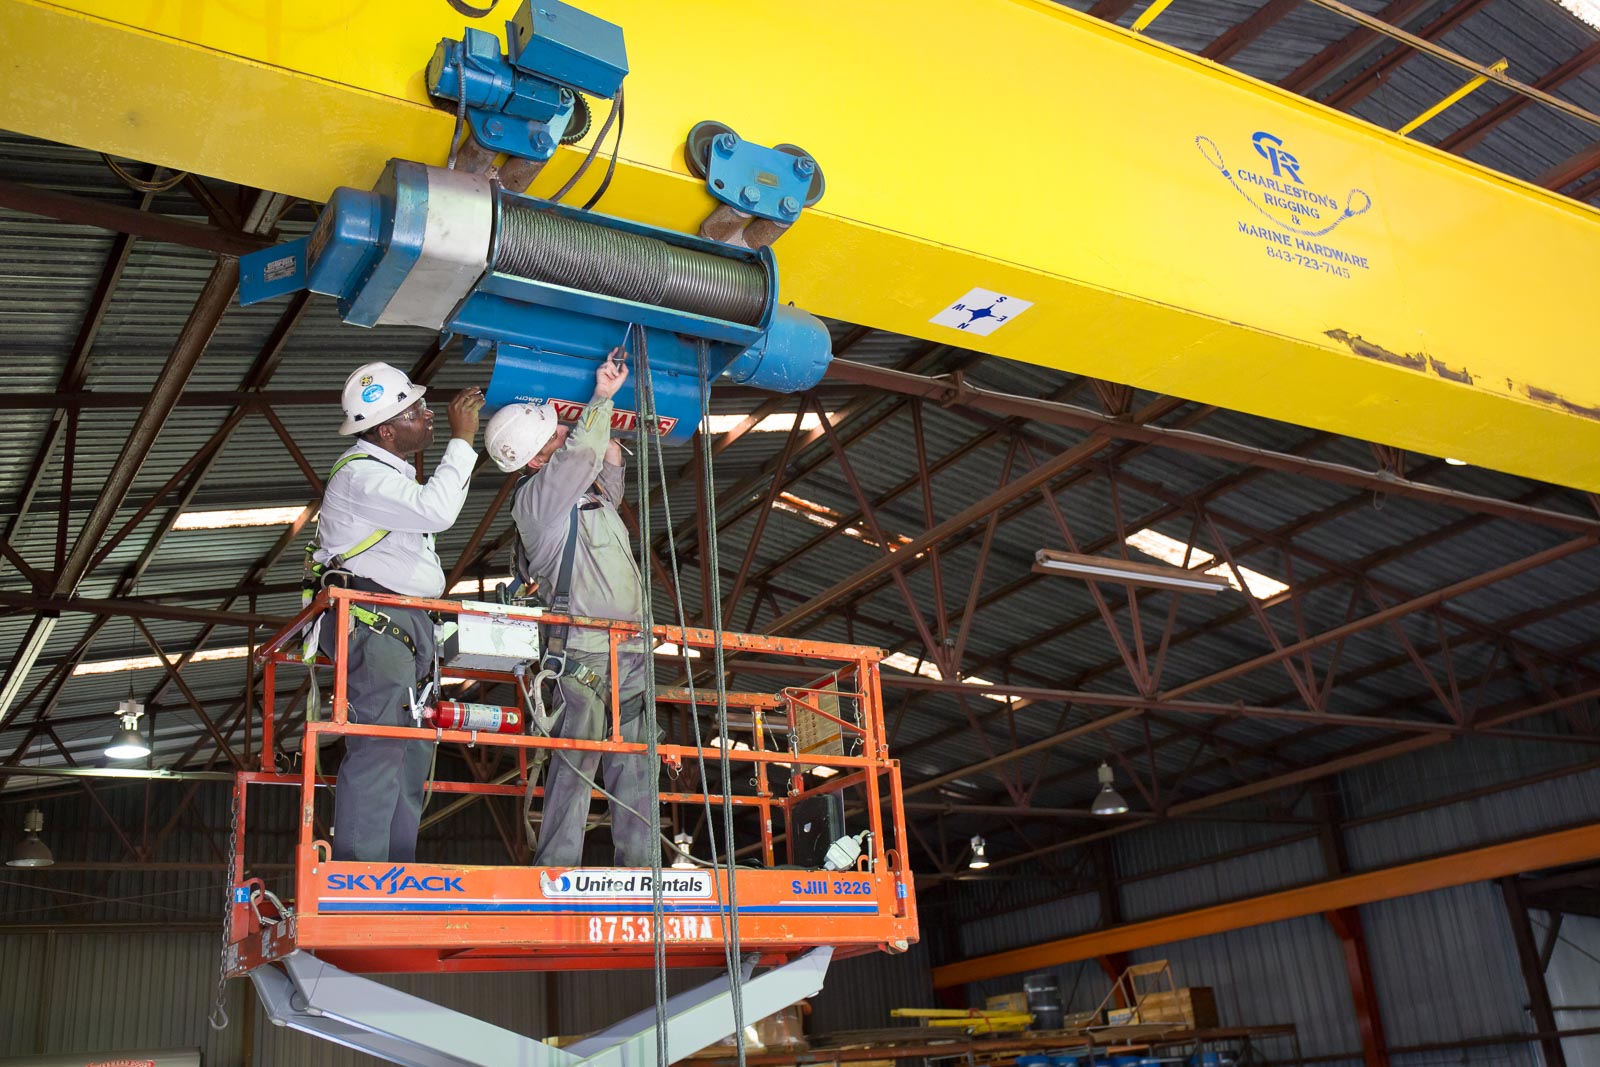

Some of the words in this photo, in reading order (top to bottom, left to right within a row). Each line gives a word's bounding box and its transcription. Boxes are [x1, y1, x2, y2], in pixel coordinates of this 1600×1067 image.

[1237, 169, 1338, 210] CHARLESTON'S
[1263, 192, 1320, 220] RIGGING
[1291, 214, 1301, 226] &
[1237, 221, 1292, 247] MARINE
[1295, 238, 1370, 270] HARDWARE
[1266, 246, 1351, 279] 843-723-7145
[951, 303, 966, 311] W
[327, 865, 466, 895] SKYJACK
[575, 876, 635, 892] United
[640, 876, 703, 892] Rntals
[791, 880, 828, 895] SJIII
[833, 881, 871, 895] 3226
